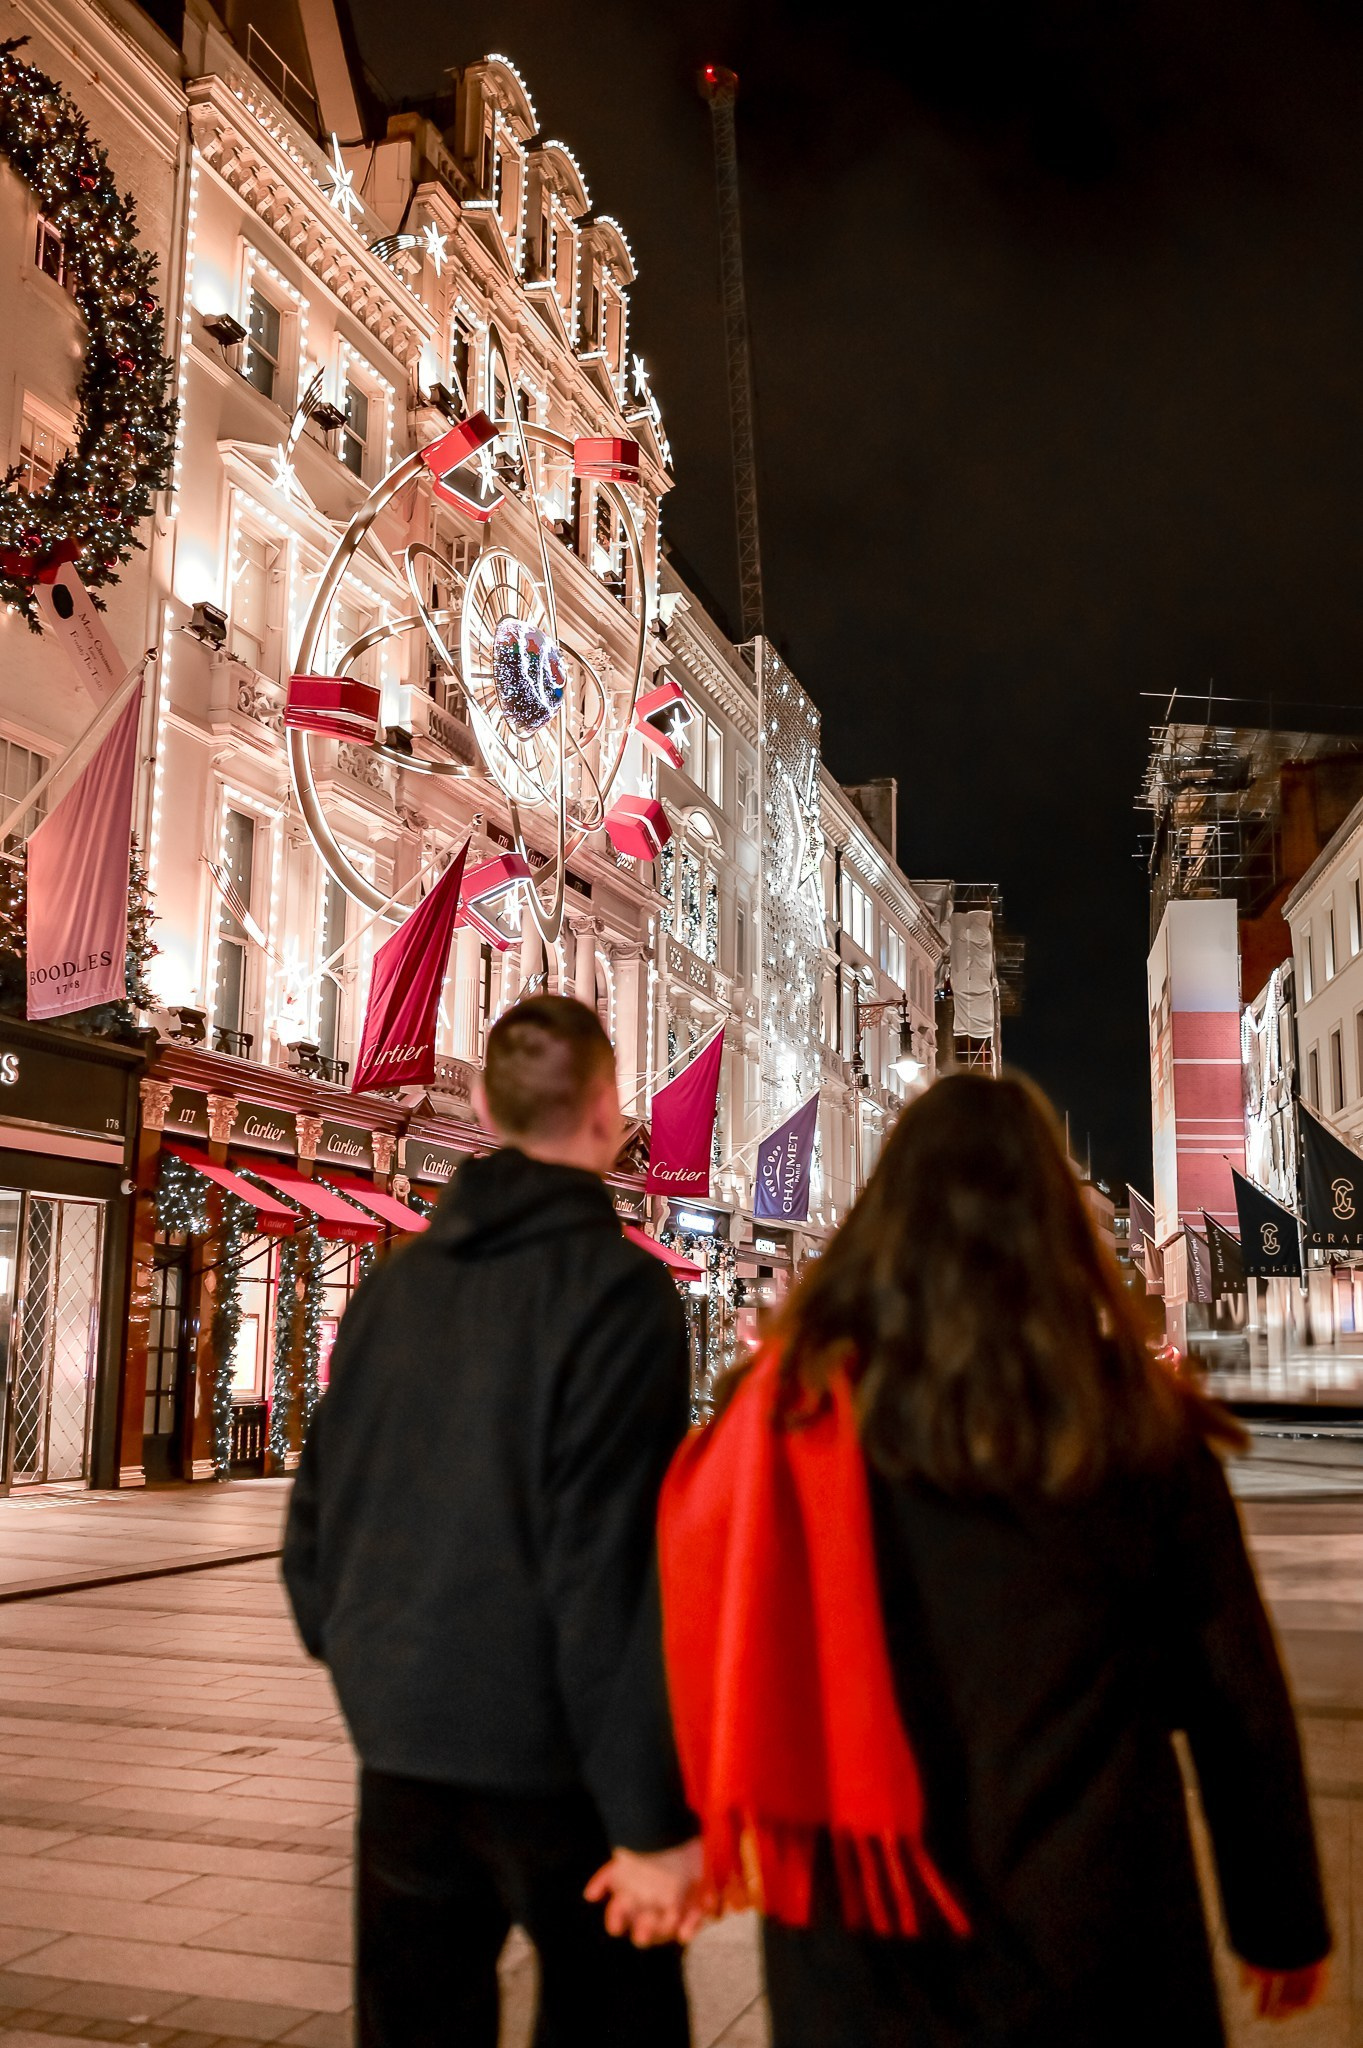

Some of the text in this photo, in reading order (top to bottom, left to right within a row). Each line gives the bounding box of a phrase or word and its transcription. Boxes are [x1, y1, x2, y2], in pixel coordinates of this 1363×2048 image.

[526, 848, 546, 868] Carti
[29, 950, 113, 986] BOODLES
[105, 1118, 120, 1130] 178
[243, 1115, 286, 1142] Cartier
[327, 1133, 364, 1158] Cartier
[652, 1161, 706, 1182] Cartier
[782, 1132, 799, 1213] CHAUMET
